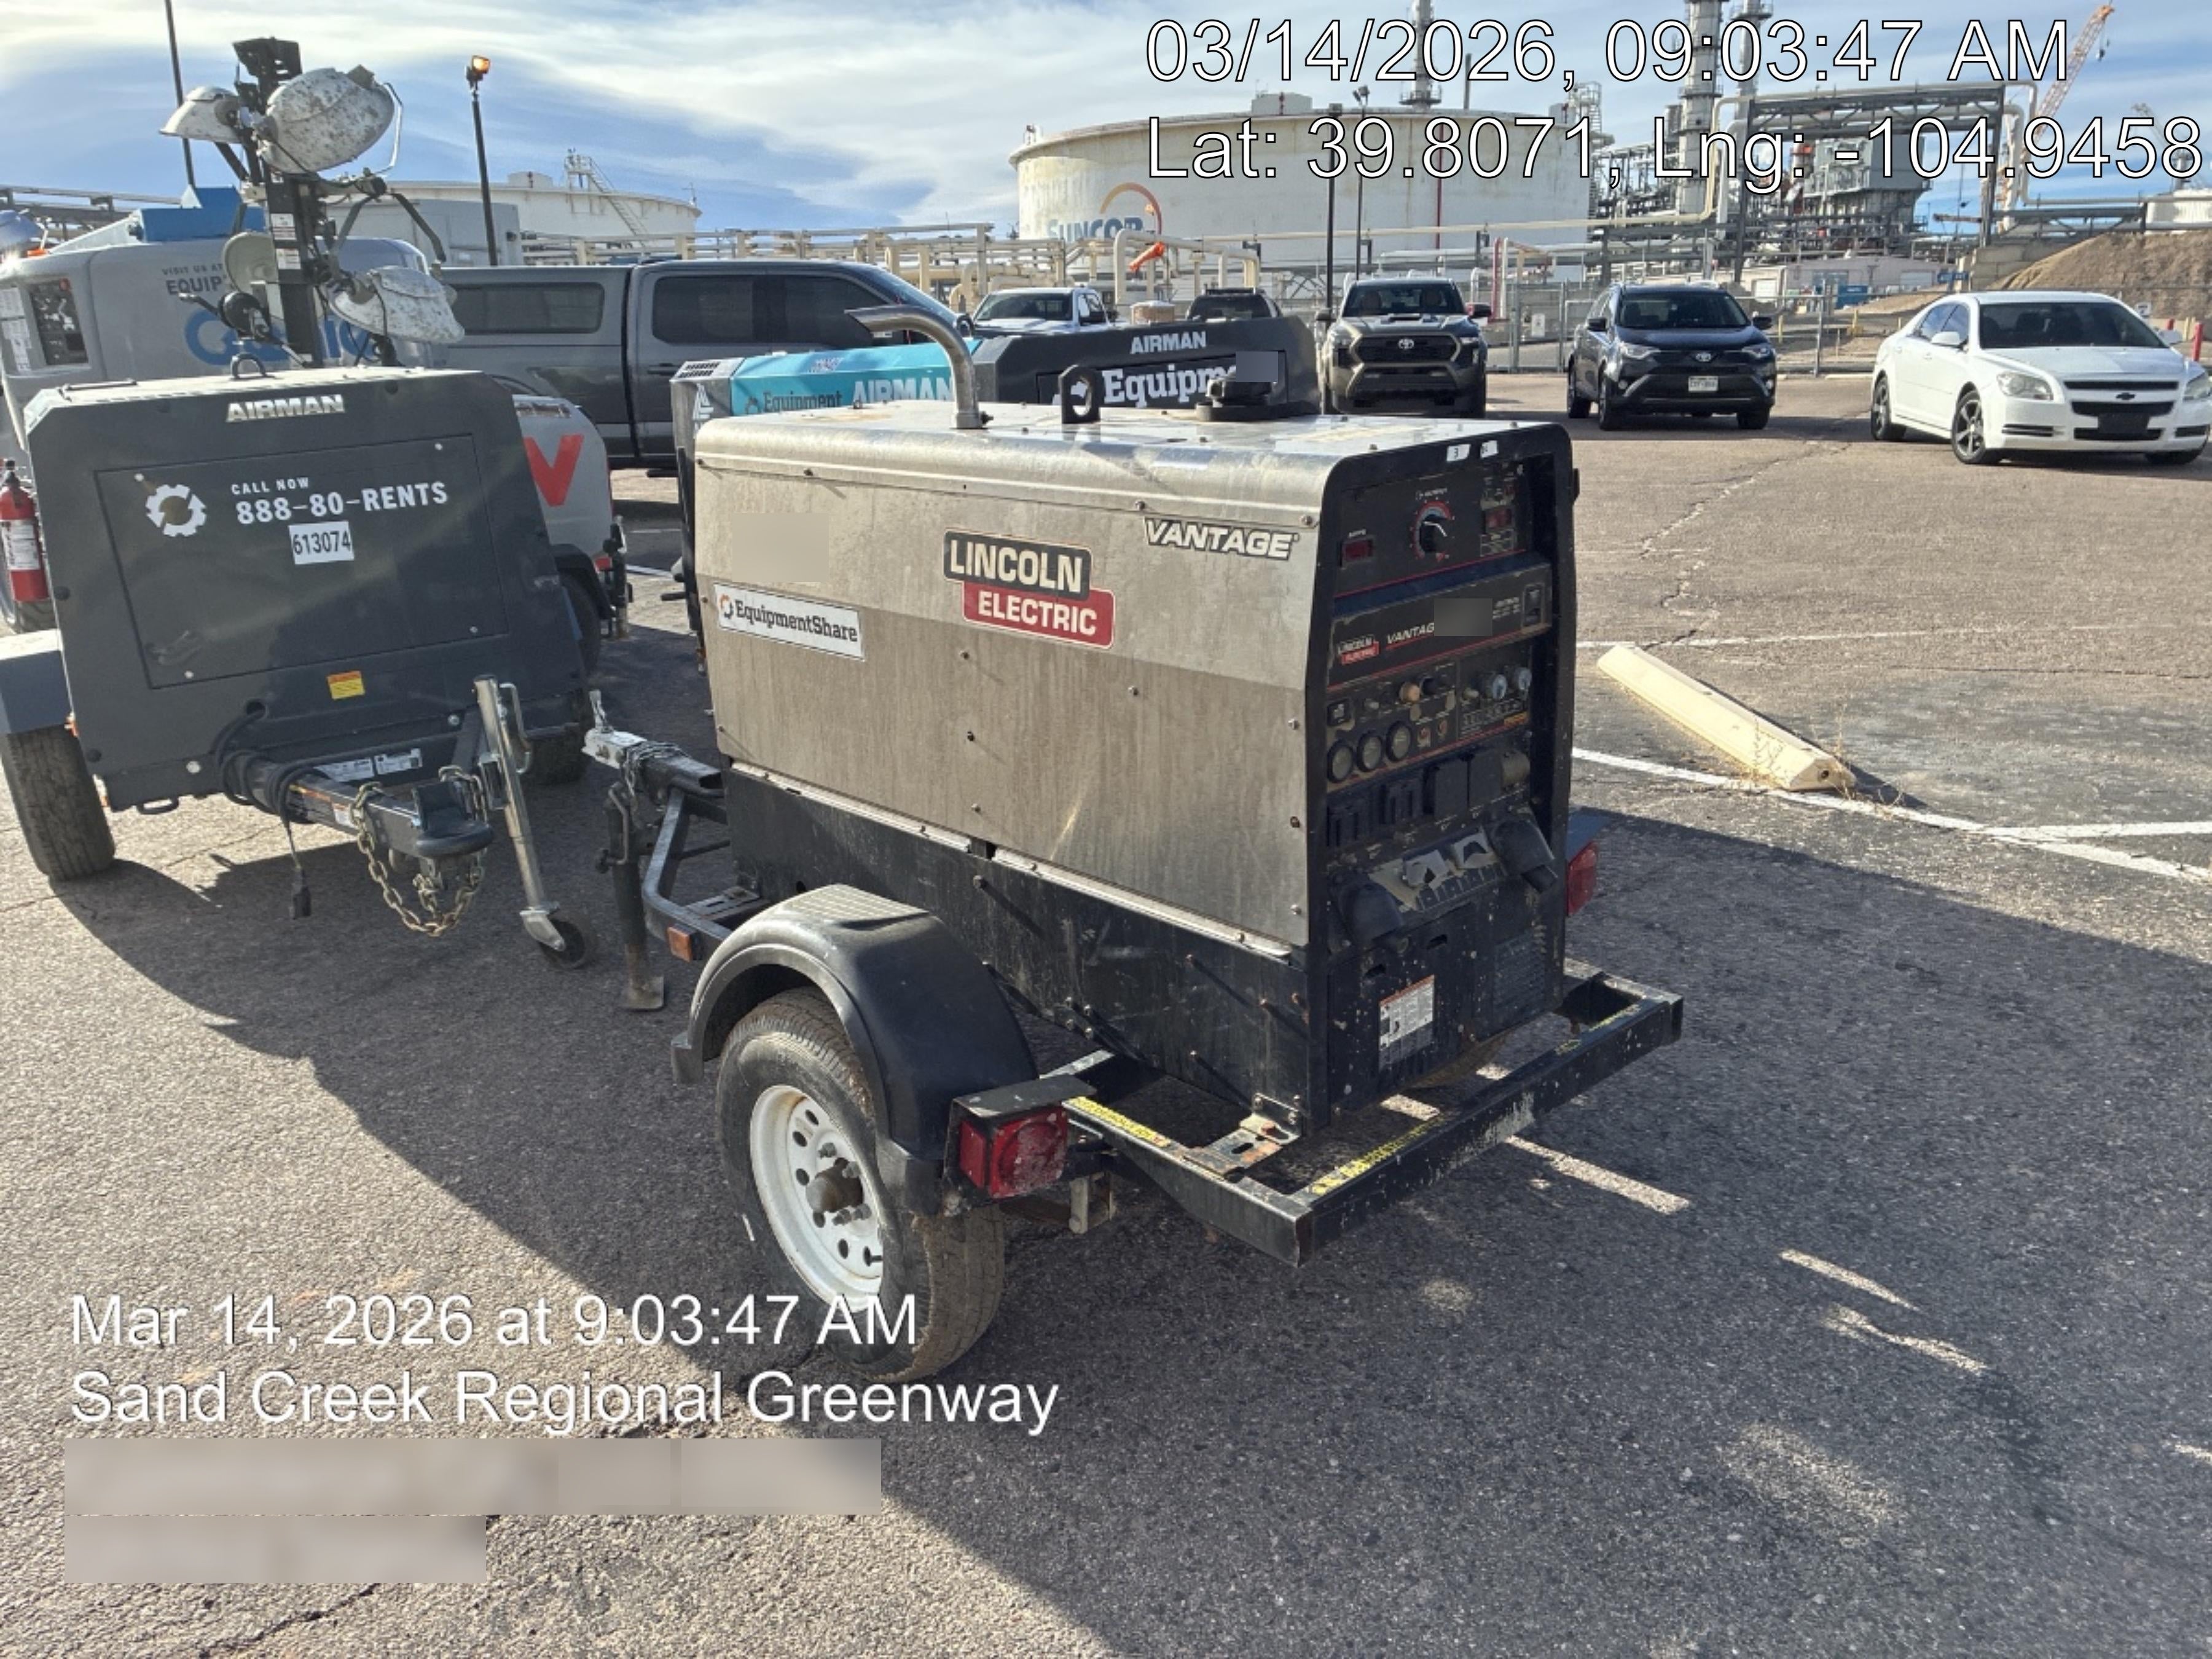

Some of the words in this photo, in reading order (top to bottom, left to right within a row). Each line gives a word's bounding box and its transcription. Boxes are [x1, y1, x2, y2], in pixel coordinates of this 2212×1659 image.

[166, 275, 226, 295] EQUIP
[1131, 331, 1207, 355] AIRMAN
[226, 394, 345, 422] AIRMAN
[231, 481, 270, 494] CALL
[276, 477, 309, 491] NOW
[235, 481, 448, 524] 888-80-RENTS
[292, 530, 350, 555] 613074
[1145, 517, 1292, 560] VANTAGE
[950, 539, 1081, 594] LINCOLN
[735, 600, 858, 641] EquipmentShare
[978, 590, 1097, 636] ELECTRIC
[1386, 622, 1435, 645] VANTAG
